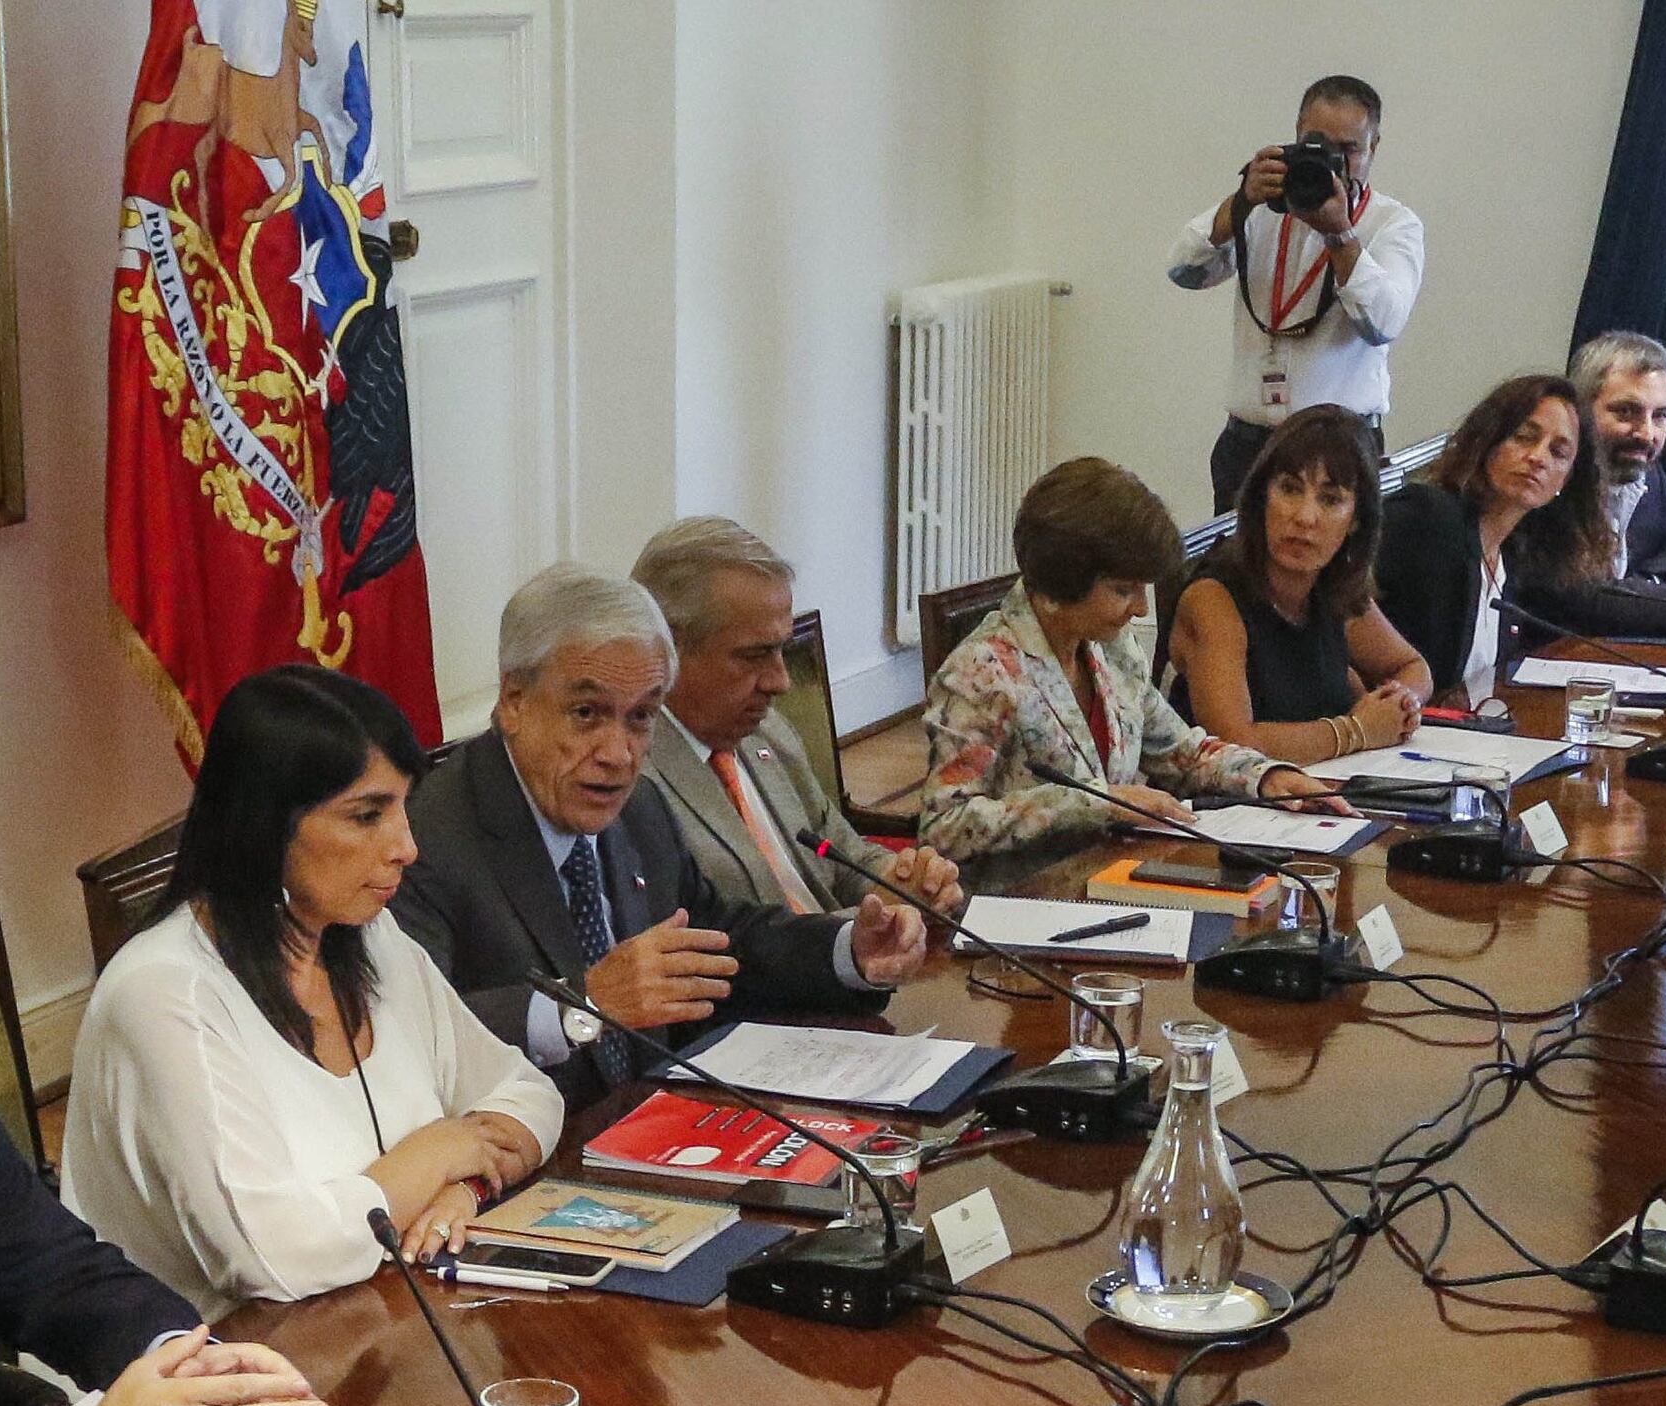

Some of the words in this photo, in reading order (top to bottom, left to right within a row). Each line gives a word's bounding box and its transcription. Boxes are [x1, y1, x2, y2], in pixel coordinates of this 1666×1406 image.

[146, 211, 170, 270] POR
[161, 276, 181, 309] LA
[222, 423, 244, 453] LA
[789, 1119, 855, 1133] LOCK
